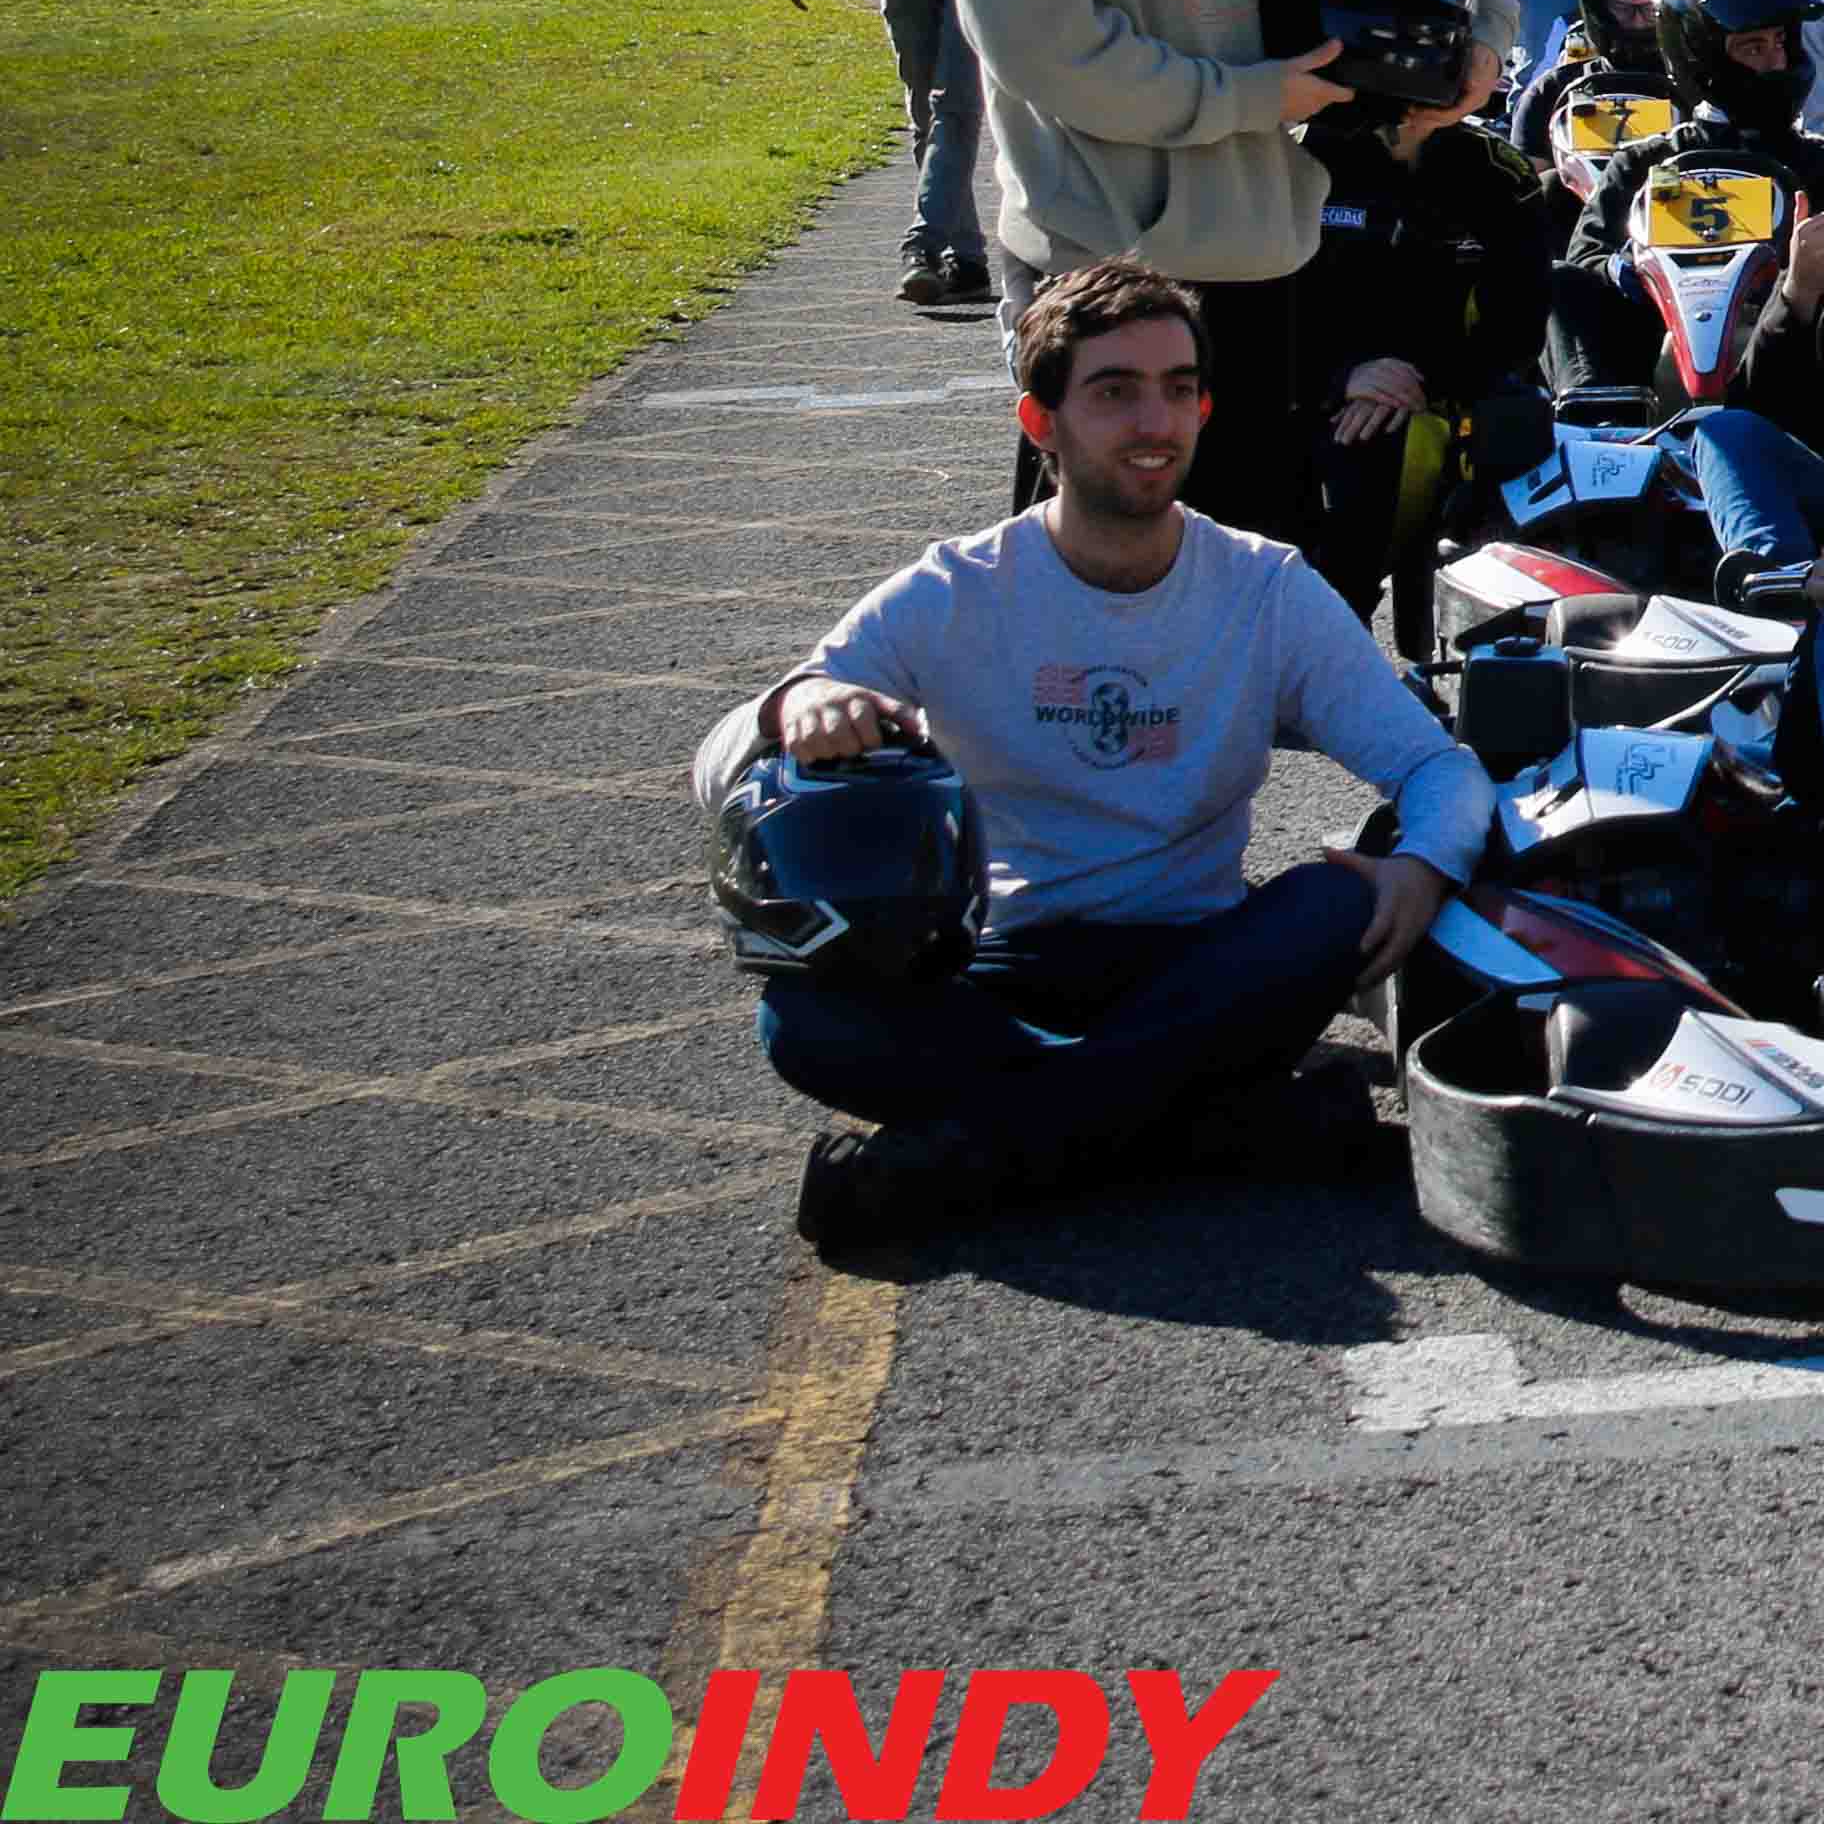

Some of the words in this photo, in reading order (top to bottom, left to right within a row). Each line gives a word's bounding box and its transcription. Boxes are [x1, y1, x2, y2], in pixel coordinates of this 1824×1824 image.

[1688, 196, 1731, 238] 5
[1035, 704, 1180, 727] WORLDWIDE
[1678, 1074, 1756, 1106] SODI
